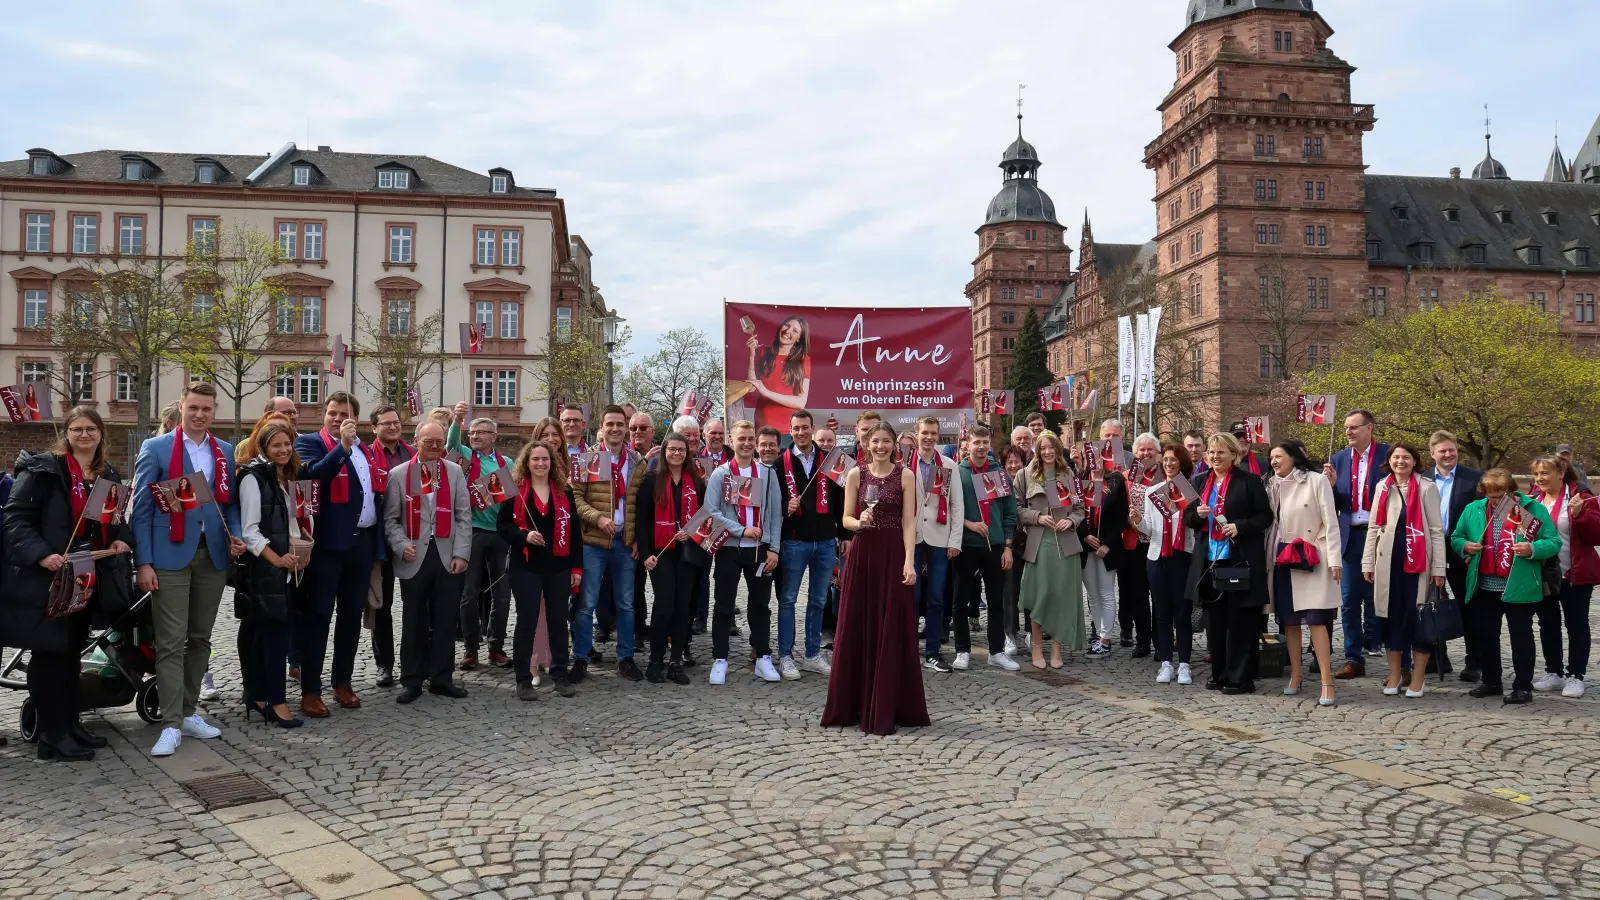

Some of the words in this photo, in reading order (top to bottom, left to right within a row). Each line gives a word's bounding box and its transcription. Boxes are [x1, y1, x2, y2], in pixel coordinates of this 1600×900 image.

[829, 313, 953, 374] Anne
[840, 378, 946, 394] Weinprinzessin
[2, 387, 21, 421] Anne
[836, 396, 859, 405] vom
[861, 394, 902, 405] Oberen
[903, 394, 954, 407] Ehegrund
[1298, 395, 1312, 421] Anne
[571, 454, 586, 481] Anne
[151, 483, 171, 512] Anne
[305, 481, 320, 515] Anne
[724, 476, 738, 502] Anne
[785, 470, 797, 499] Ann
[1150, 492, 1170, 517] Anne
[558, 506, 571, 548] Anne
[1519, 519, 1540, 541] Anne
[705, 531, 729, 554] Anne
[1405, 522, 1425, 566] Anne
[1498, 528, 1516, 570] Anne
